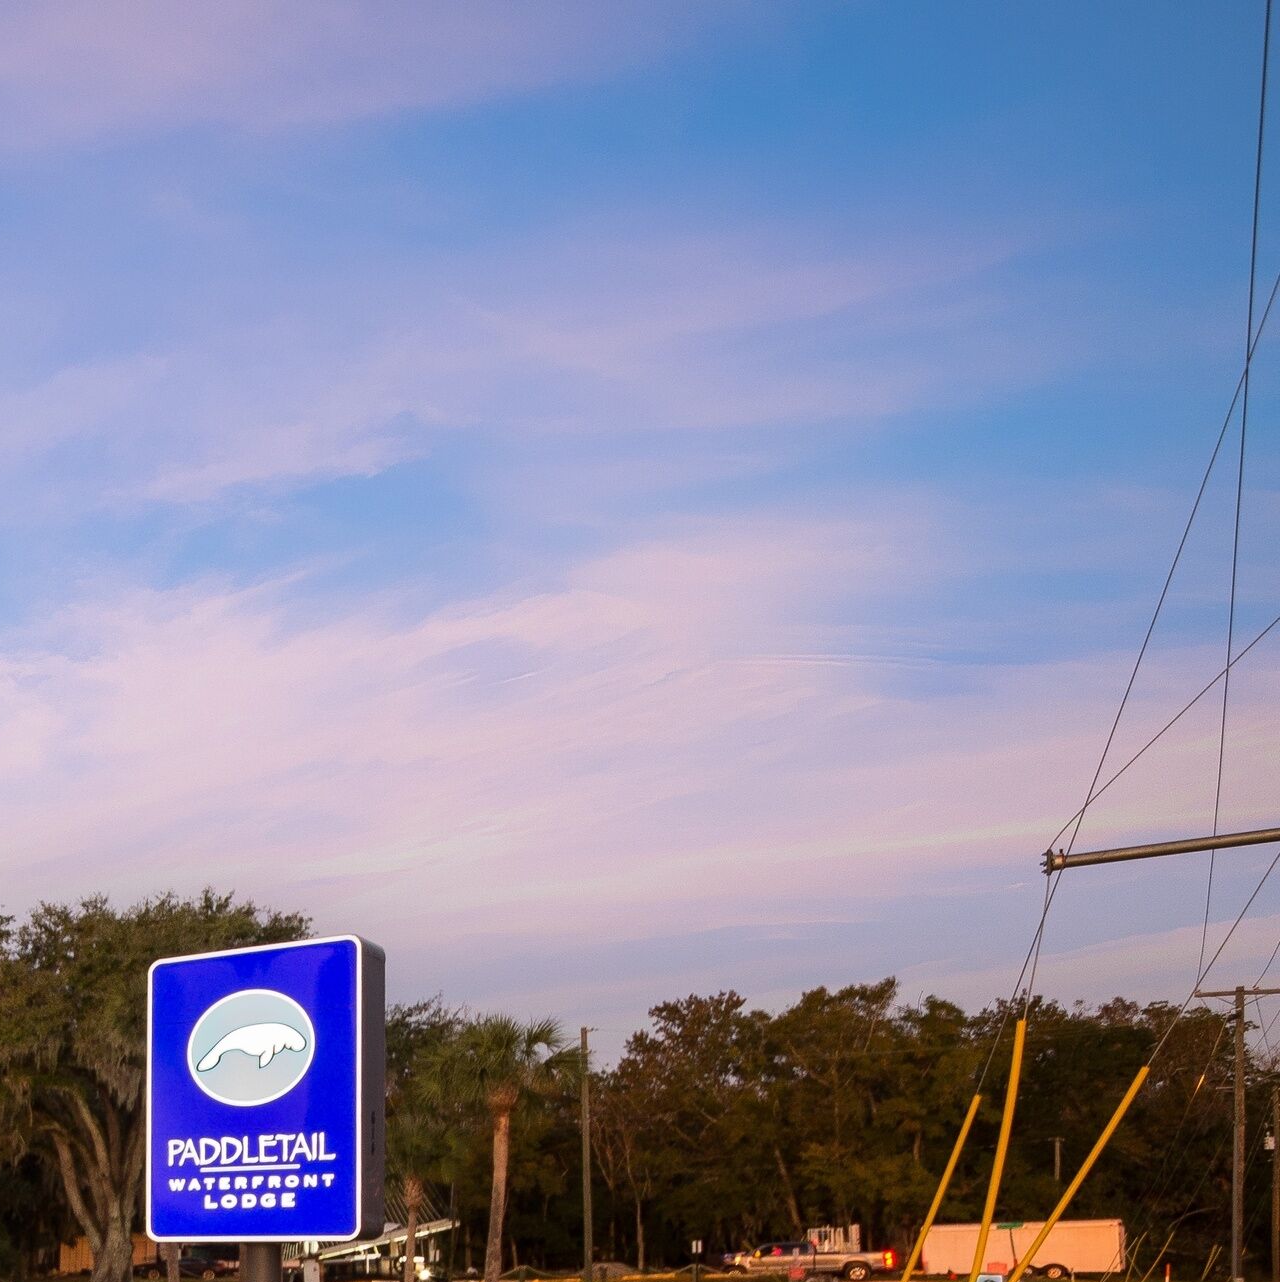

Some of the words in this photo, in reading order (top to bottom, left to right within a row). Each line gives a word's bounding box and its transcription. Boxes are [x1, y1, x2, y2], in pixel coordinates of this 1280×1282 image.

[167, 1132, 337, 1167] PADDLETAIL
[168, 1173, 335, 1191] WATERFRONT
[203, 1192, 296, 1210] LODGE
